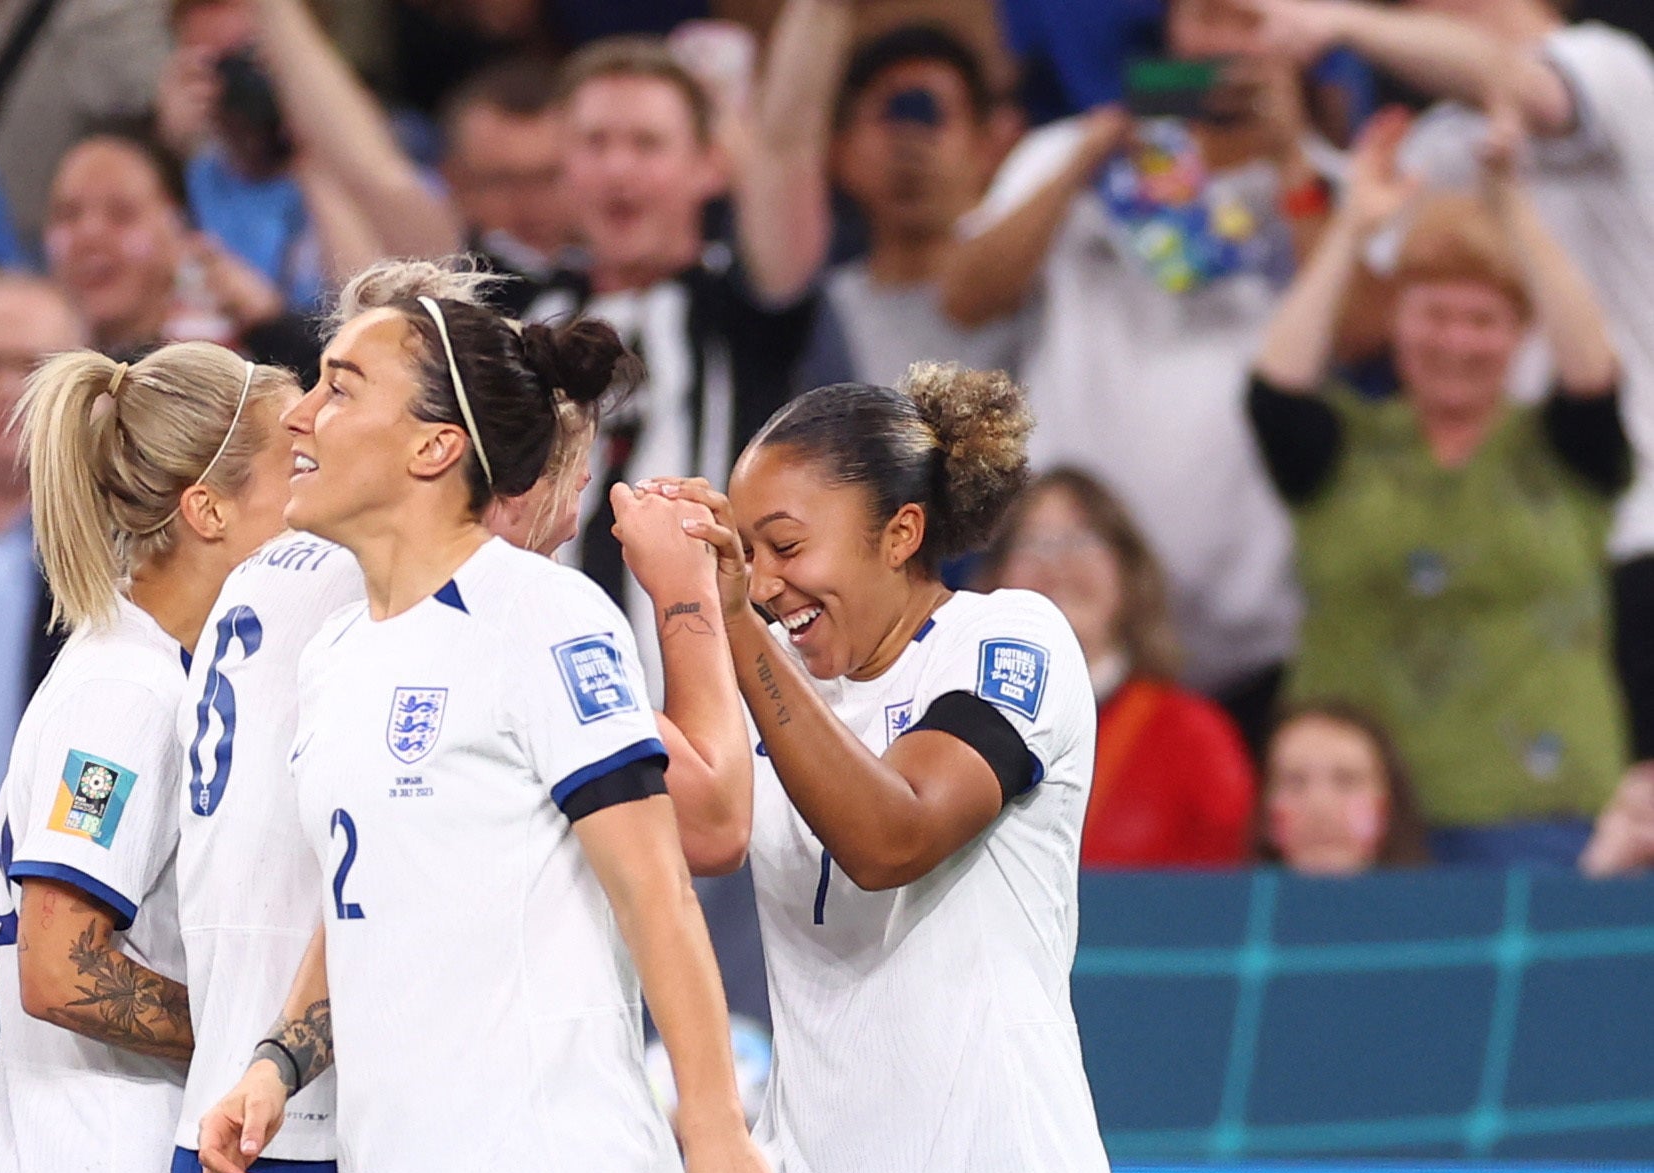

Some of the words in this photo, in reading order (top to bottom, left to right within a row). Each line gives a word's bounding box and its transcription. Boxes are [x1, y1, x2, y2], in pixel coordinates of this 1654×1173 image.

[994, 647, 1036, 664] FOOTBALL
[994, 657, 1036, 678] UNITES
[189, 604, 263, 817] 6
[330, 808, 366, 919] 2
